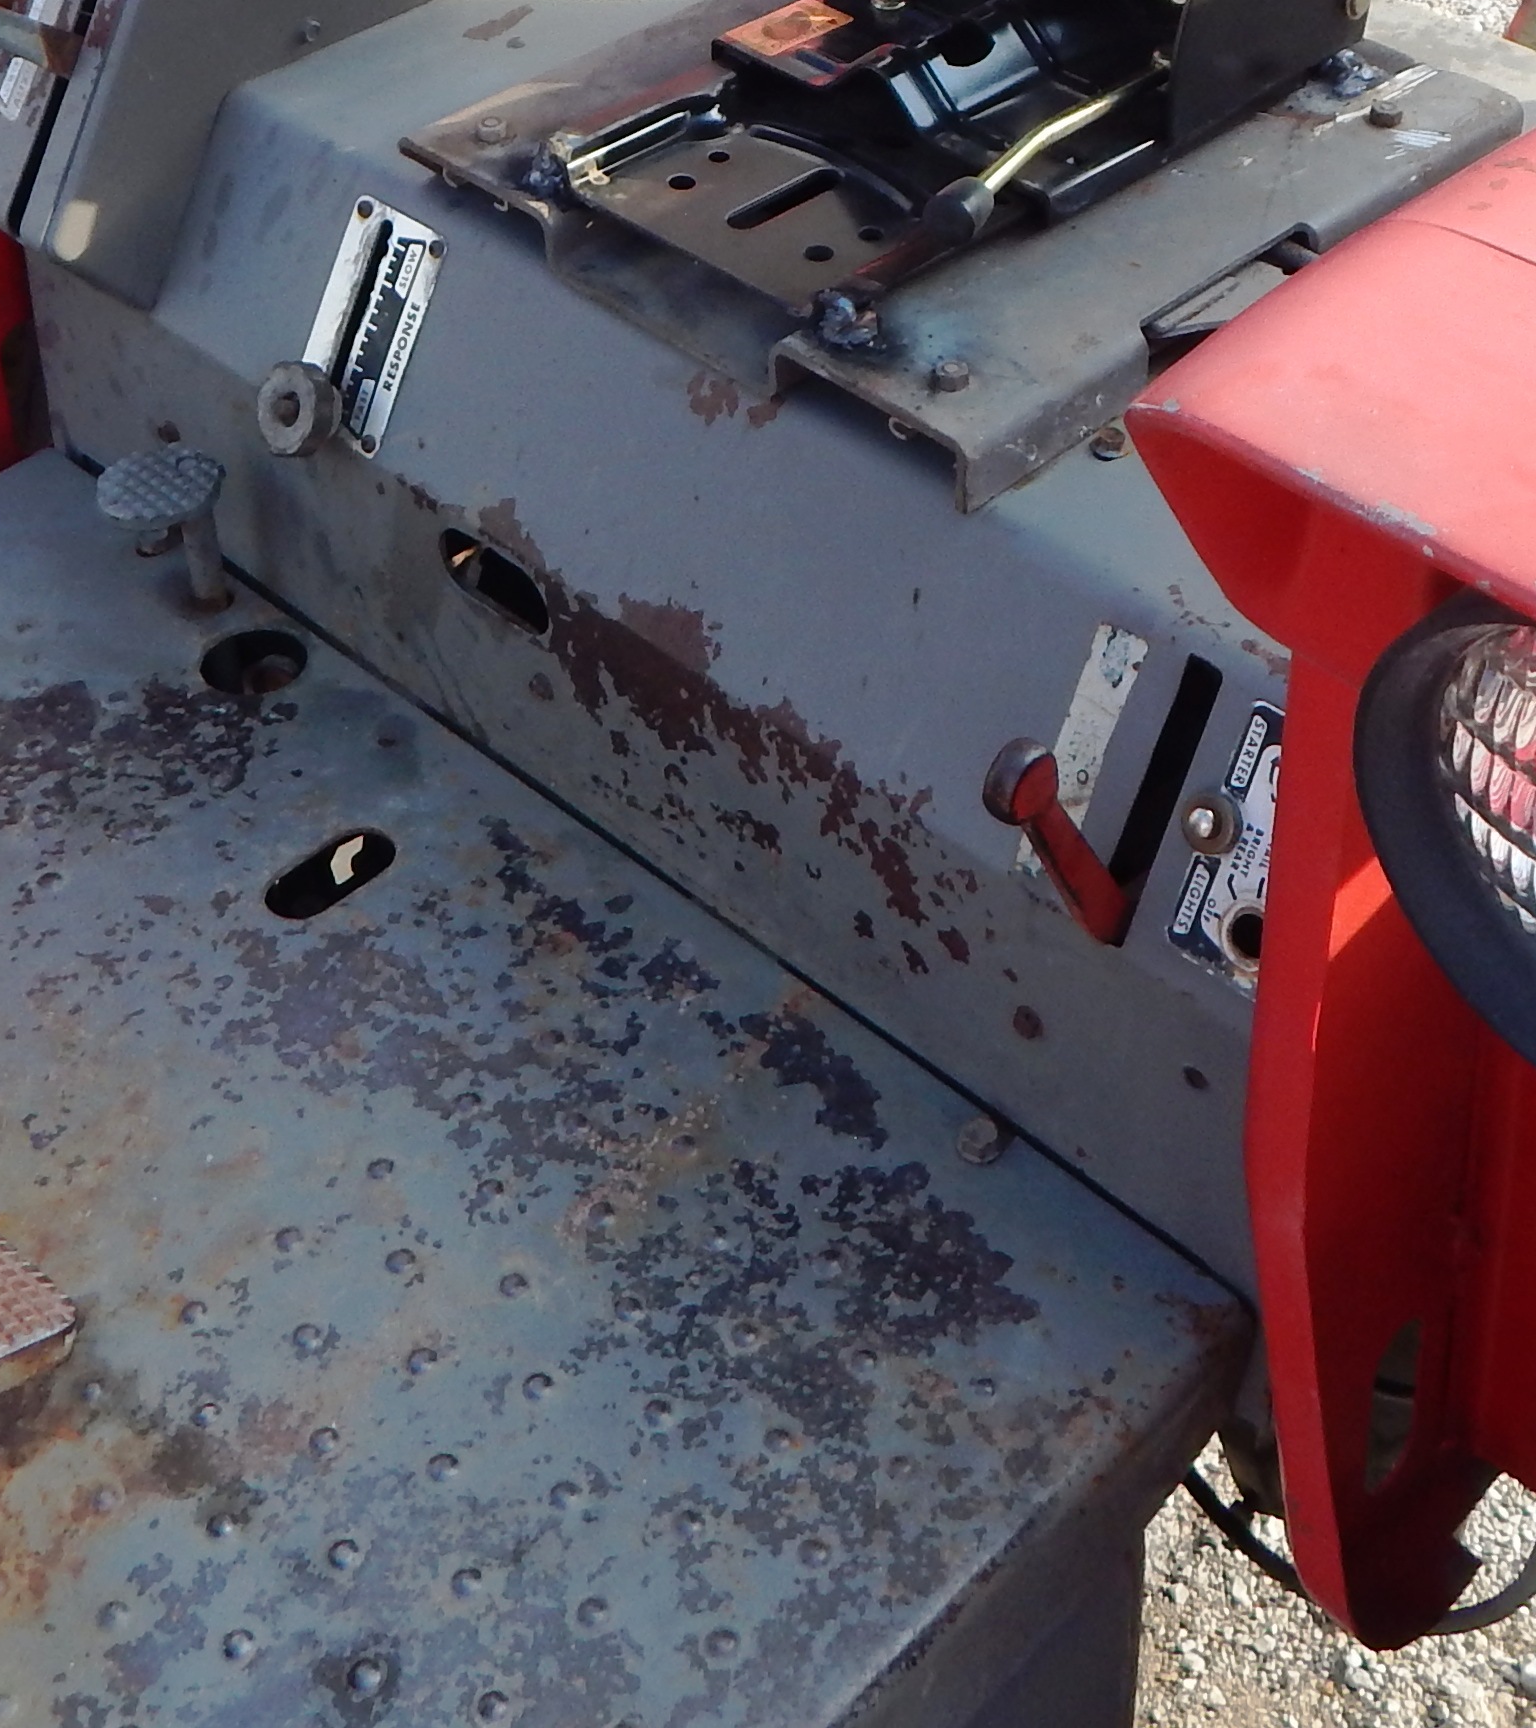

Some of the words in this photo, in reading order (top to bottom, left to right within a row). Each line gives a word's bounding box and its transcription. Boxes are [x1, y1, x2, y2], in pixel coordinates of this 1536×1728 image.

[398, 249, 418, 289] SLOW
[382, 301, 421, 392] RESPONSE
[1233, 719, 1265, 785] STARTER
[1231, 837, 1249, 870] REAR
[1240, 828, 1264, 878] BRIGHT
[1177, 873, 1207, 931] LIGHTS
